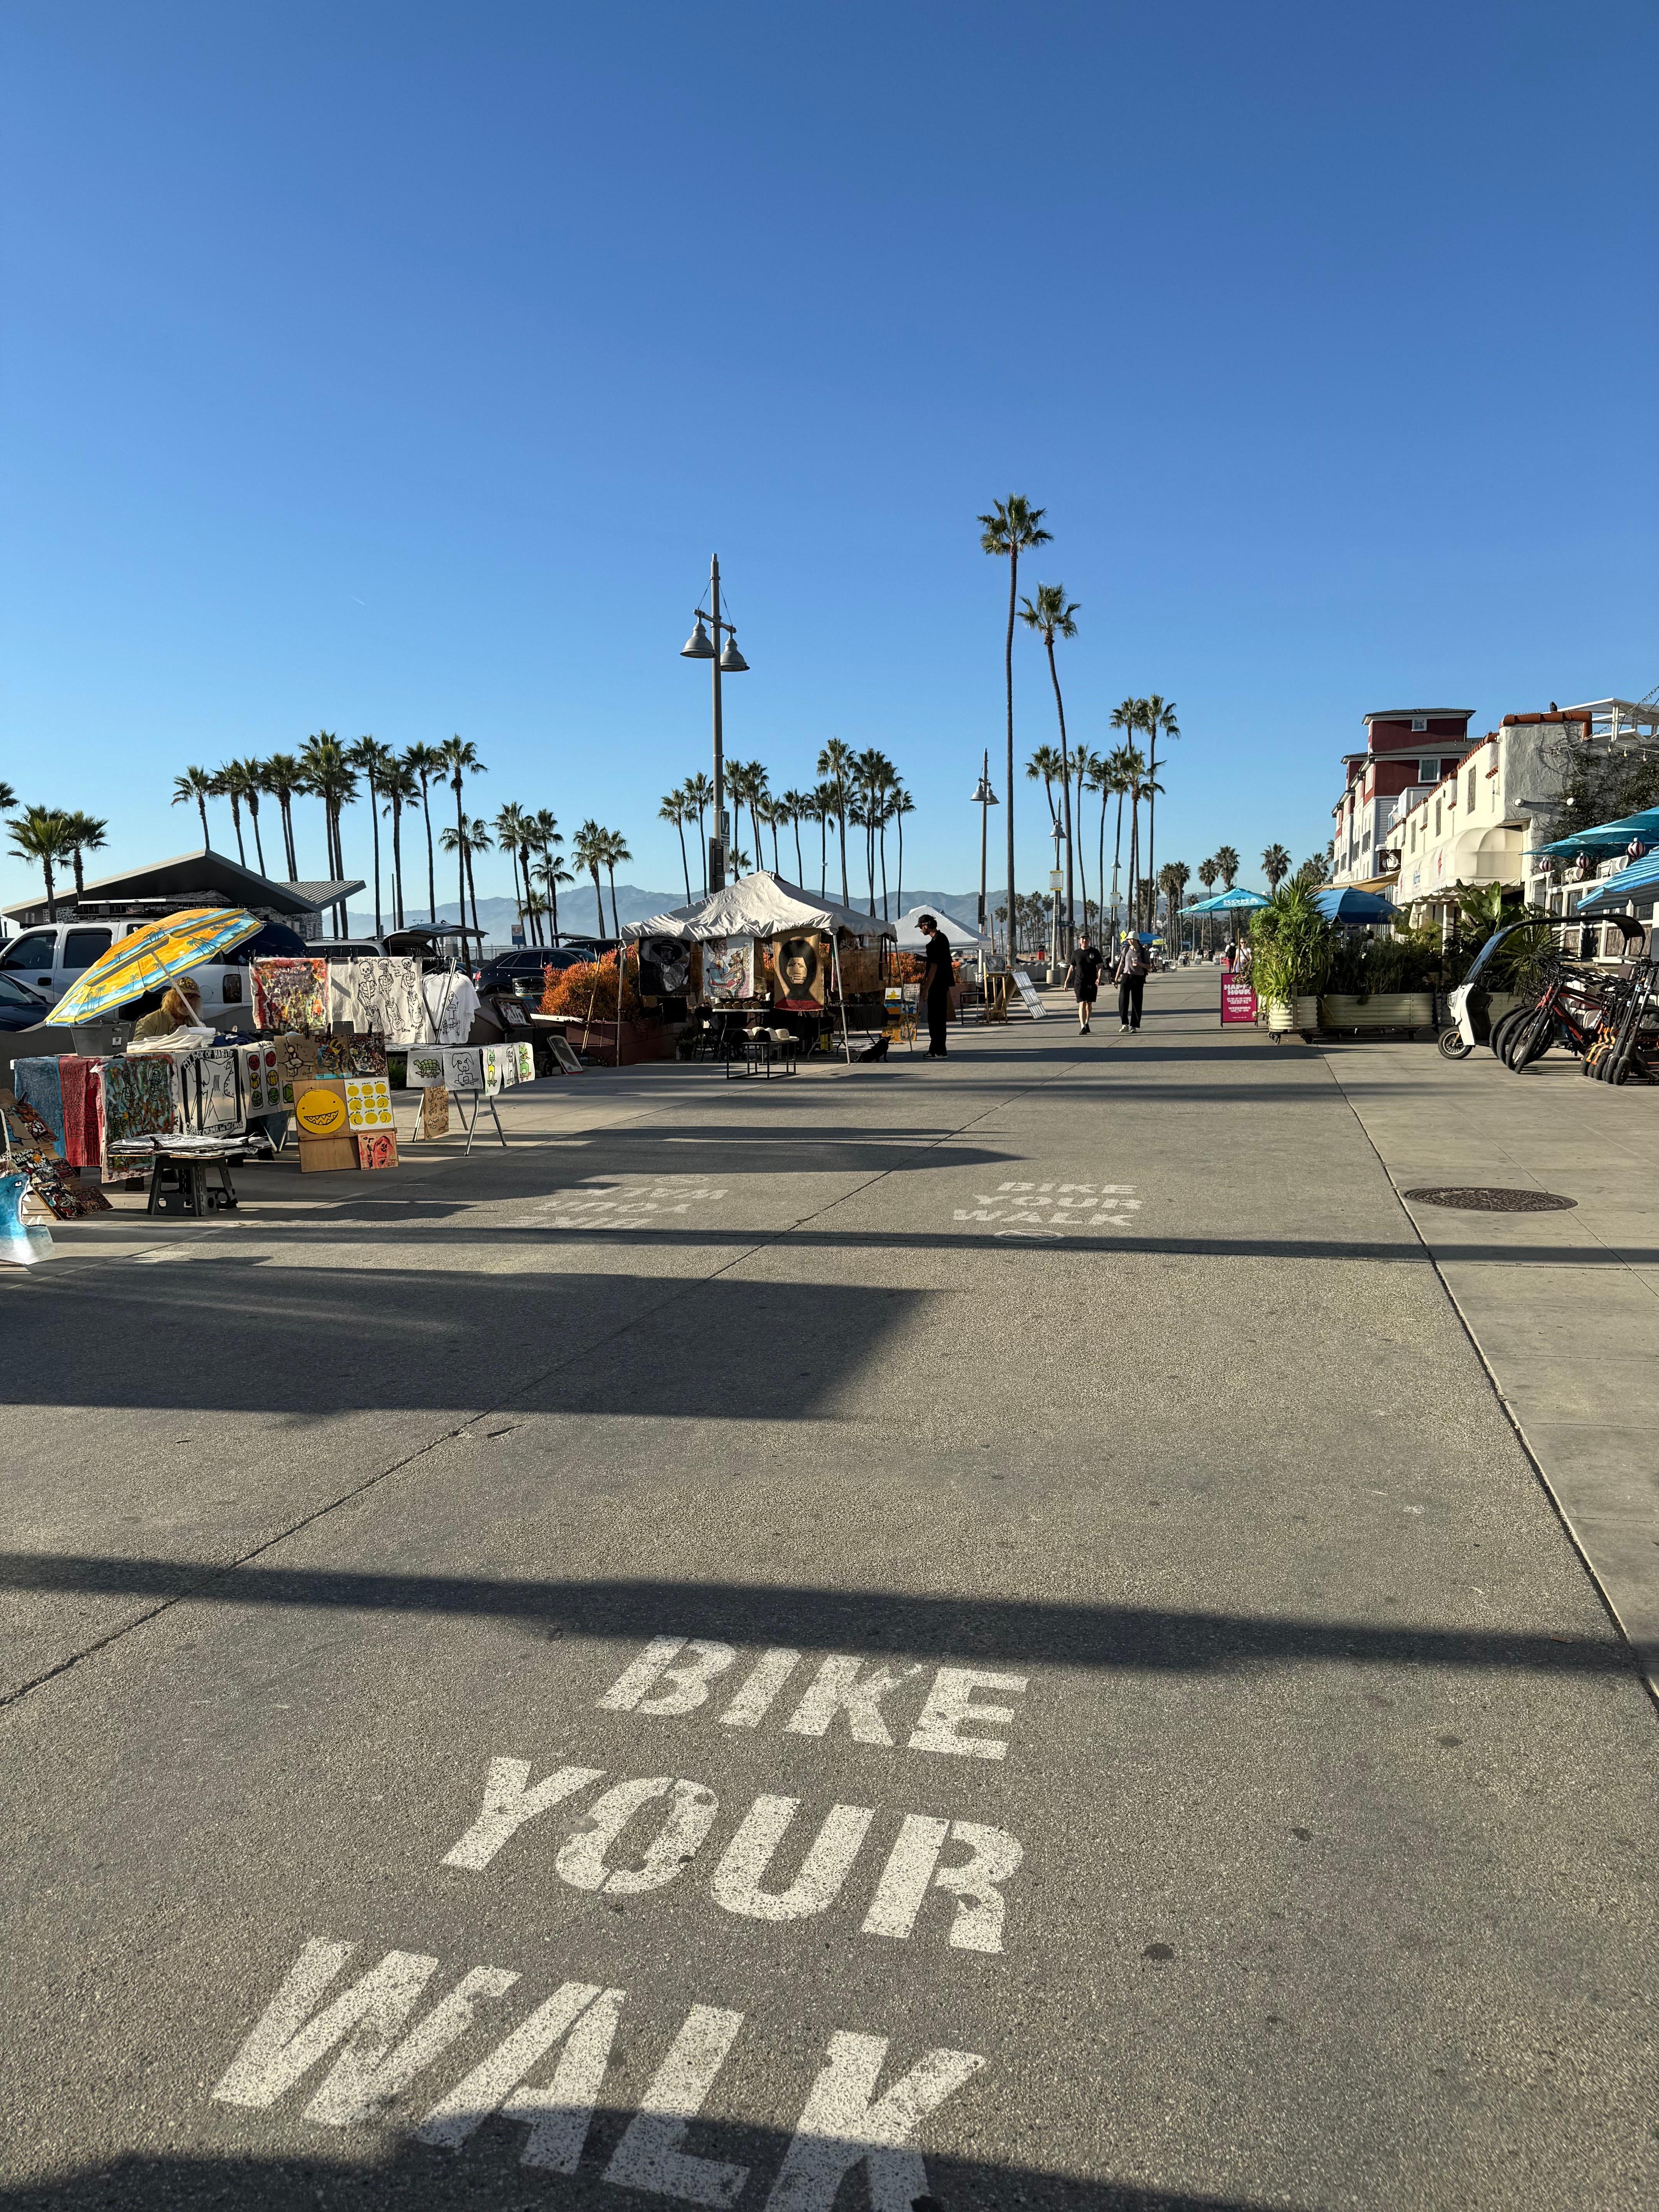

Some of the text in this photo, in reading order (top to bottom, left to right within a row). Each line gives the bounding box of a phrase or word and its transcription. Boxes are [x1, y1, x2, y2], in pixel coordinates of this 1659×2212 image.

[192, 1051, 204, 1060] BOX
[205, 1050, 212, 1058] OF
[570, 1187, 729, 1199] WALK
[996, 1182, 1137, 1194] BIKE
[533, 1201, 692, 1214] YOUR
[973, 1194, 1143, 1209] YOUR
[498, 1216, 655, 1228] BIKE
[953, 1209, 1136, 1226] WALK
[595, 1634, 1028, 1760] BIKE
[441, 1756, 1024, 1954] YOUR
[211, 1936, 987, 2212] WALK
